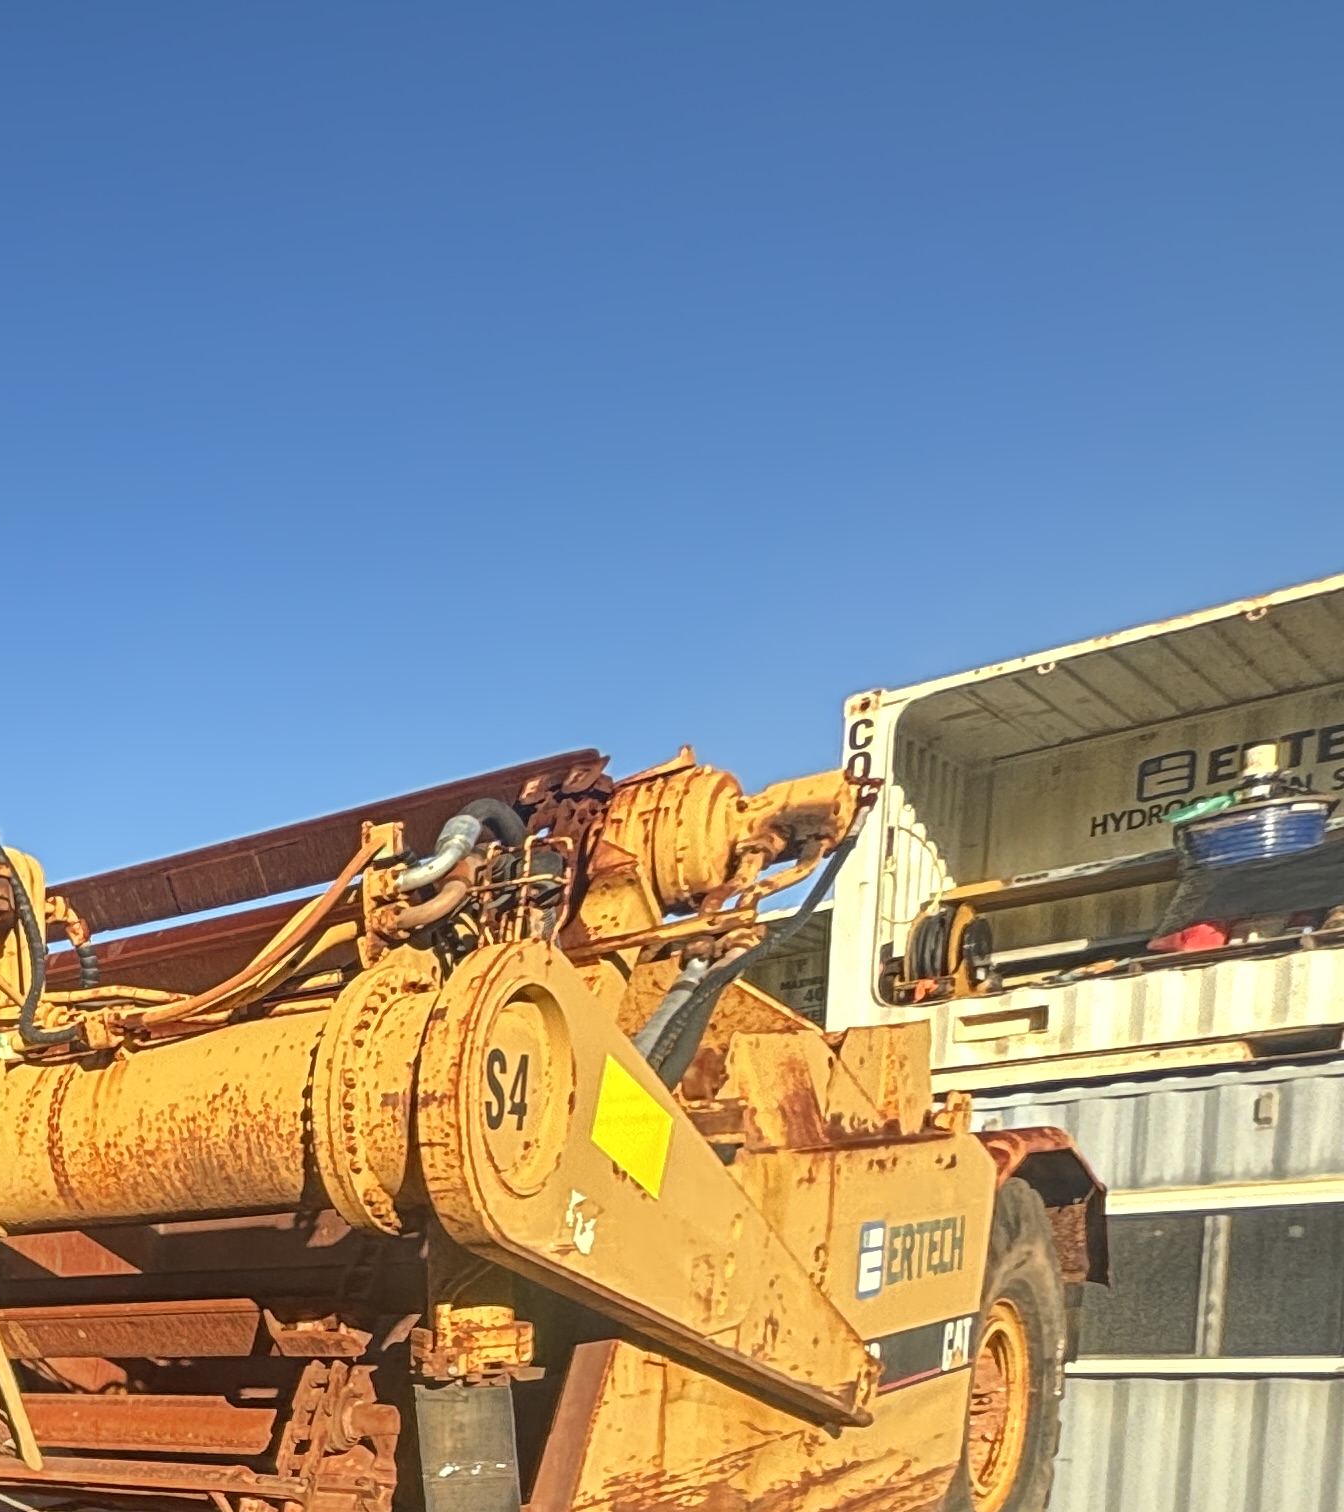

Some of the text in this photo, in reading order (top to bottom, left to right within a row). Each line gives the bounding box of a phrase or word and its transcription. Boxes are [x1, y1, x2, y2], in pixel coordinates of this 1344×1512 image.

[485, 1048, 529, 1131] S4
[885, 1215, 965, 1286] ERTECH
[941, 1317, 973, 1372] CAT
